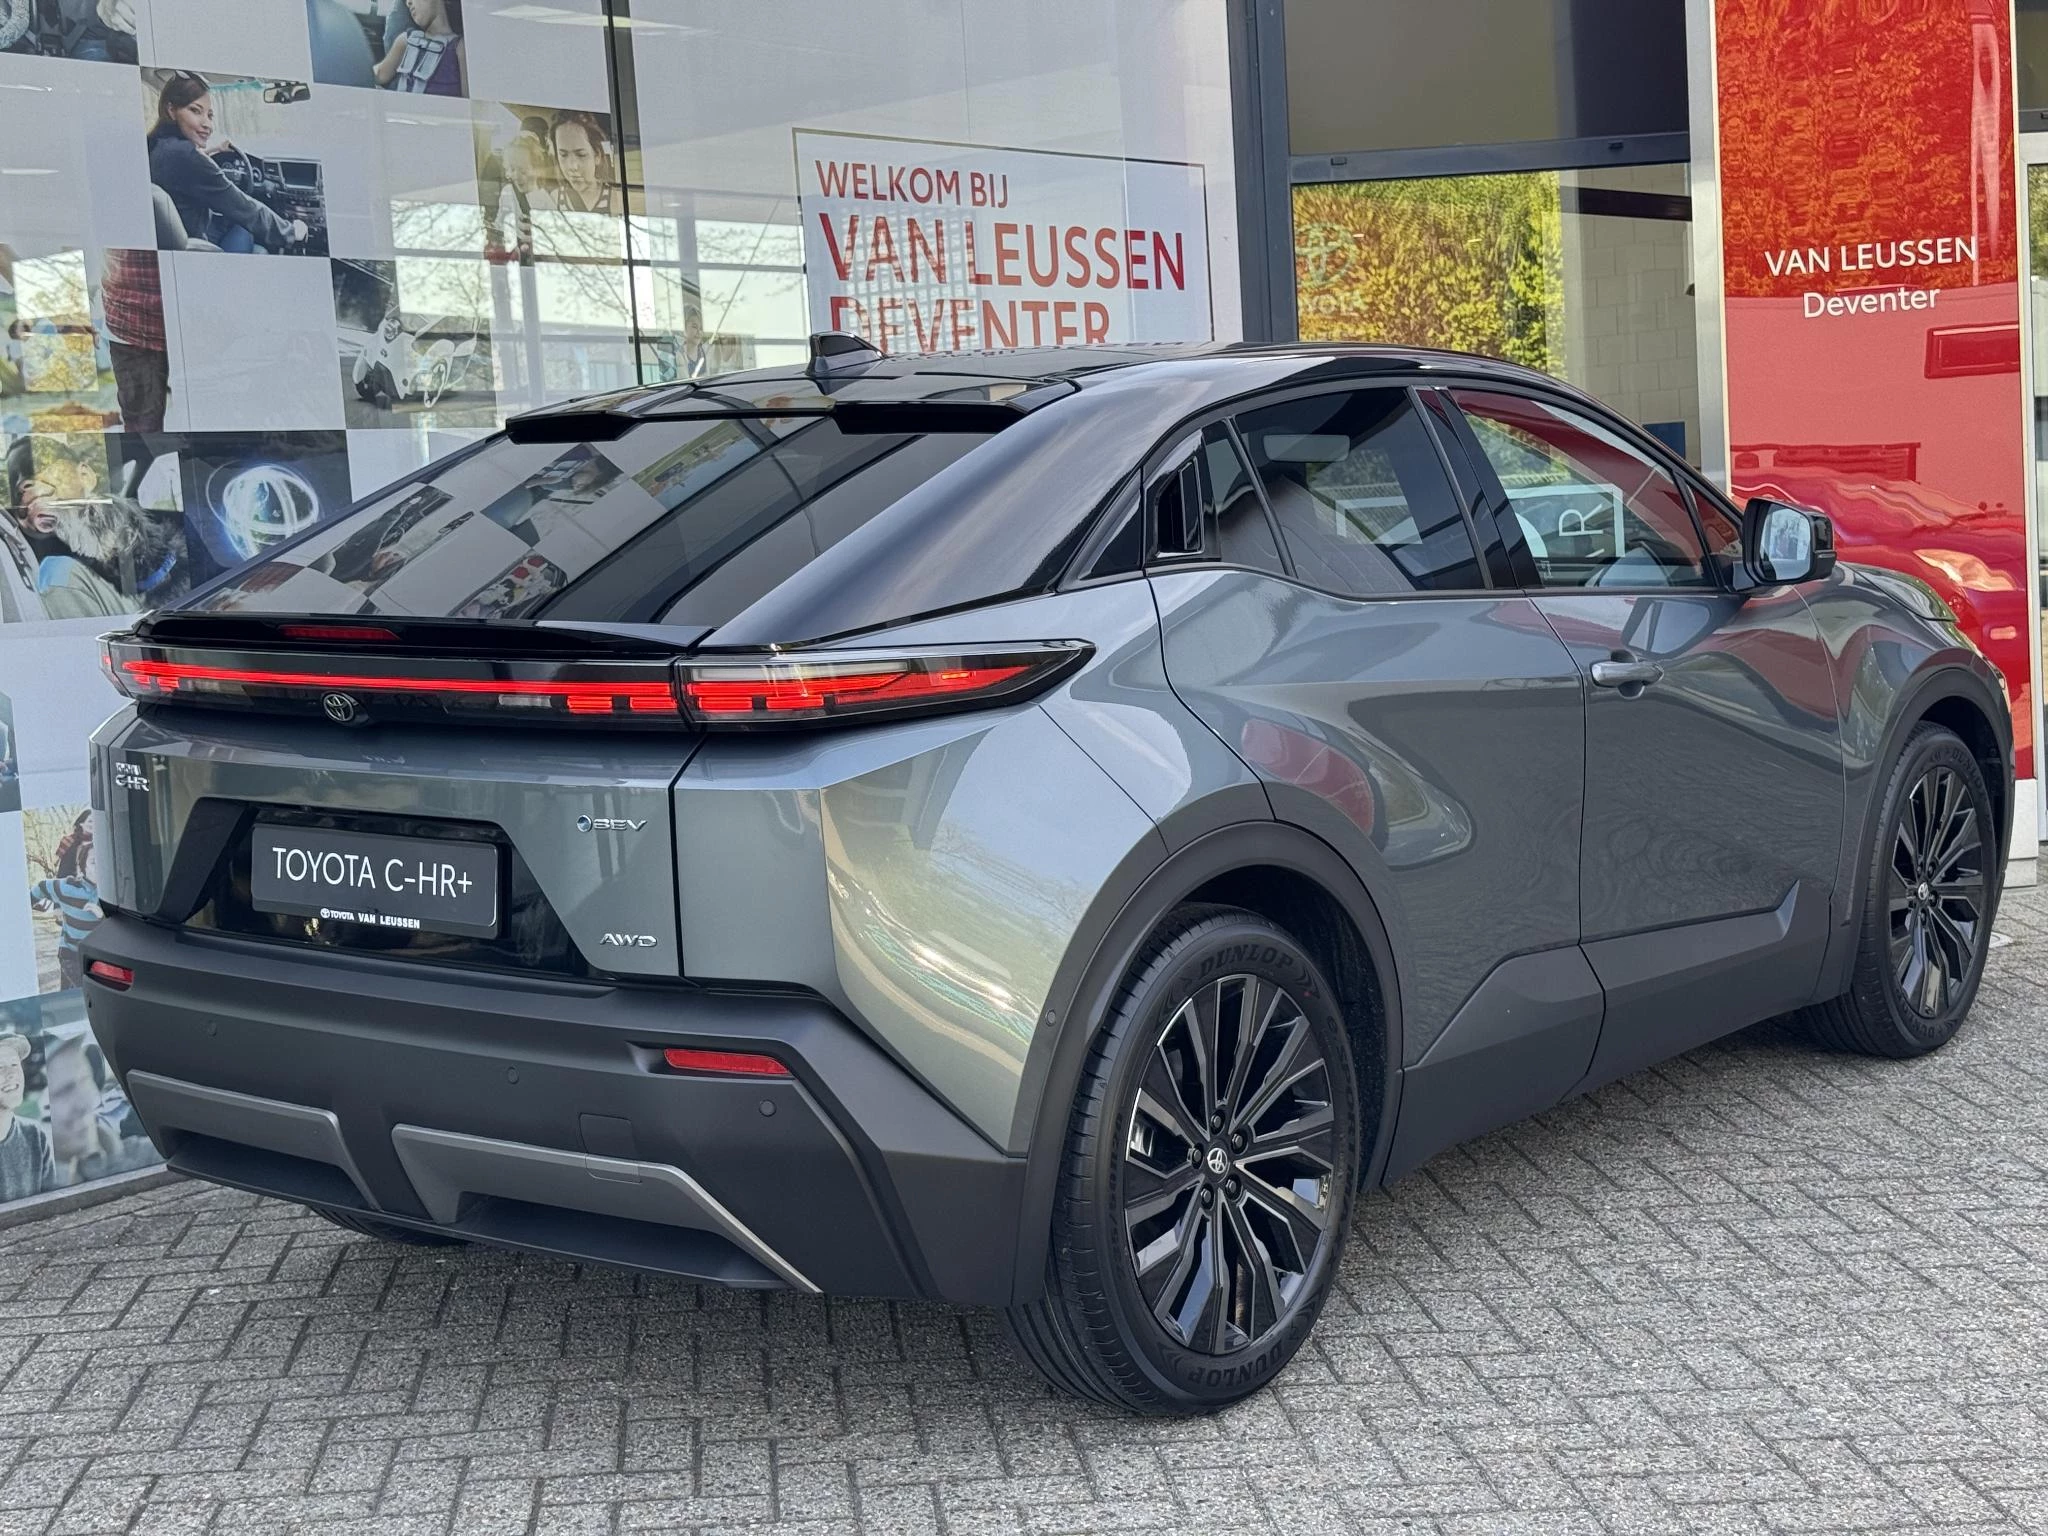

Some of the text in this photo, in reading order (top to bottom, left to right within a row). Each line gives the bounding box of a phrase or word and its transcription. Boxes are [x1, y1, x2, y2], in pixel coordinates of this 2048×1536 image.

[815, 160, 1009, 209] WELKOM BIJ
[819, 212, 1185, 291] VAN LEUSSEN
[1764, 236, 1977, 277] VAN LEUSSEN
[1802, 286, 1941, 319] Deventer
[592, 818, 647, 831] BEV
[272, 847, 473, 898] TOYOTA C-HR+
[330, 909, 420, 929] TOYOTA VAN LEUSSEN
[599, 933, 657, 947] AWD
[1198, 943, 1295, 980] DUNLOP
[1188, 1340, 1283, 1388] DUNLOP
